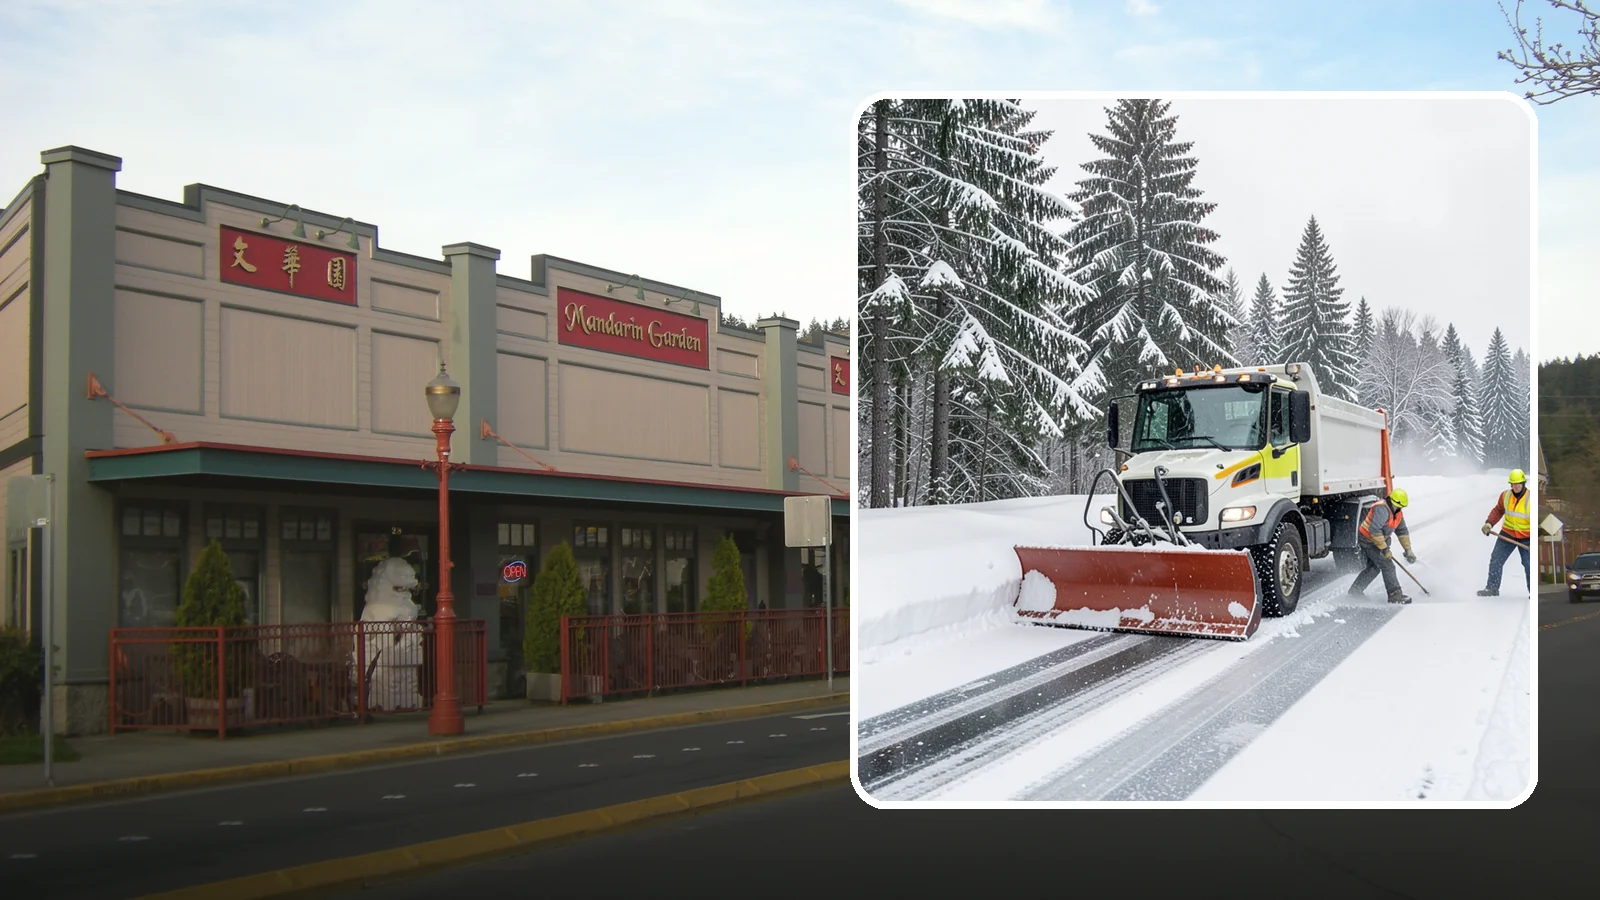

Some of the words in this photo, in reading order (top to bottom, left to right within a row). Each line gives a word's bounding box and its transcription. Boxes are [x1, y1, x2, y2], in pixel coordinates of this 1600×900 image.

[230, 235, 346, 291] 文華園
[564, 302, 644, 341] Mandarin
[647, 320, 702, 352] Garden
[503, 565, 527, 578] OPEN
